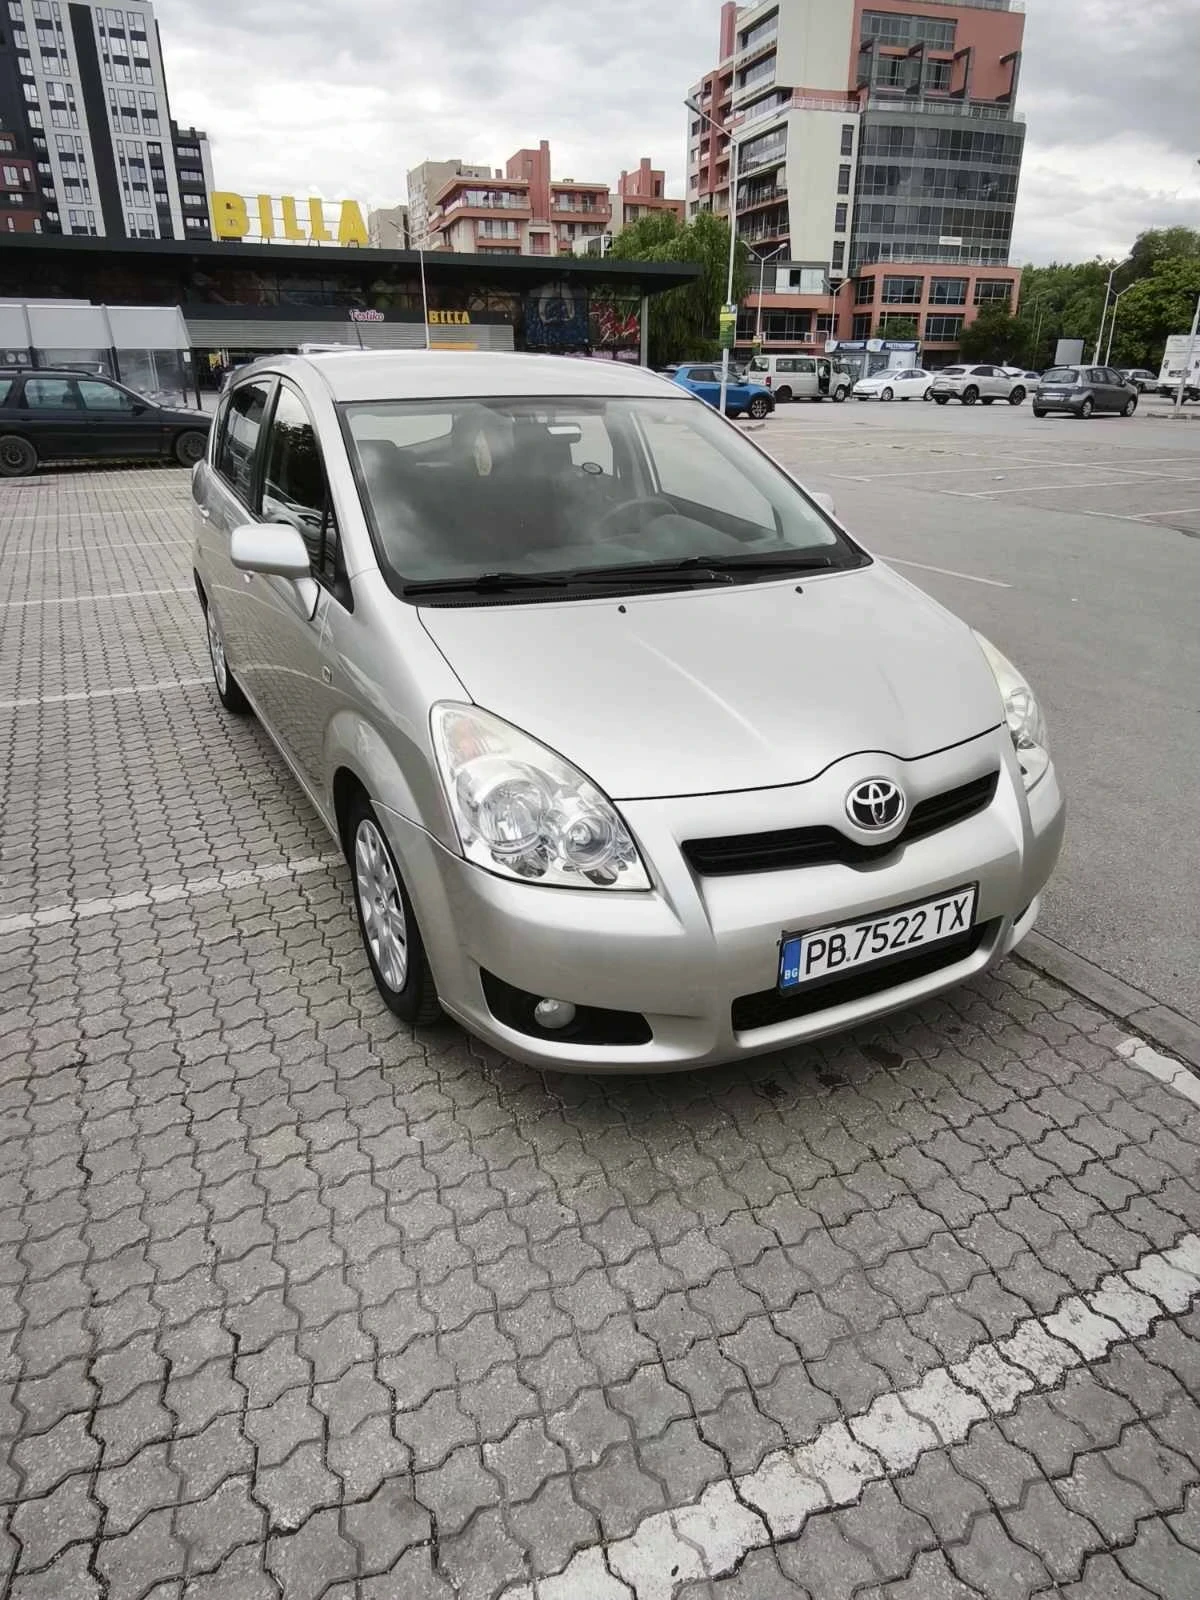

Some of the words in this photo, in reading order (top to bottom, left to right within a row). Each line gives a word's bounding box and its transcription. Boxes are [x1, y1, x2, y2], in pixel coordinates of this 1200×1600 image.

[211, 191, 370, 248] BILLA
[428, 310, 471, 324] BILLA
[784, 967, 799, 980] BG
